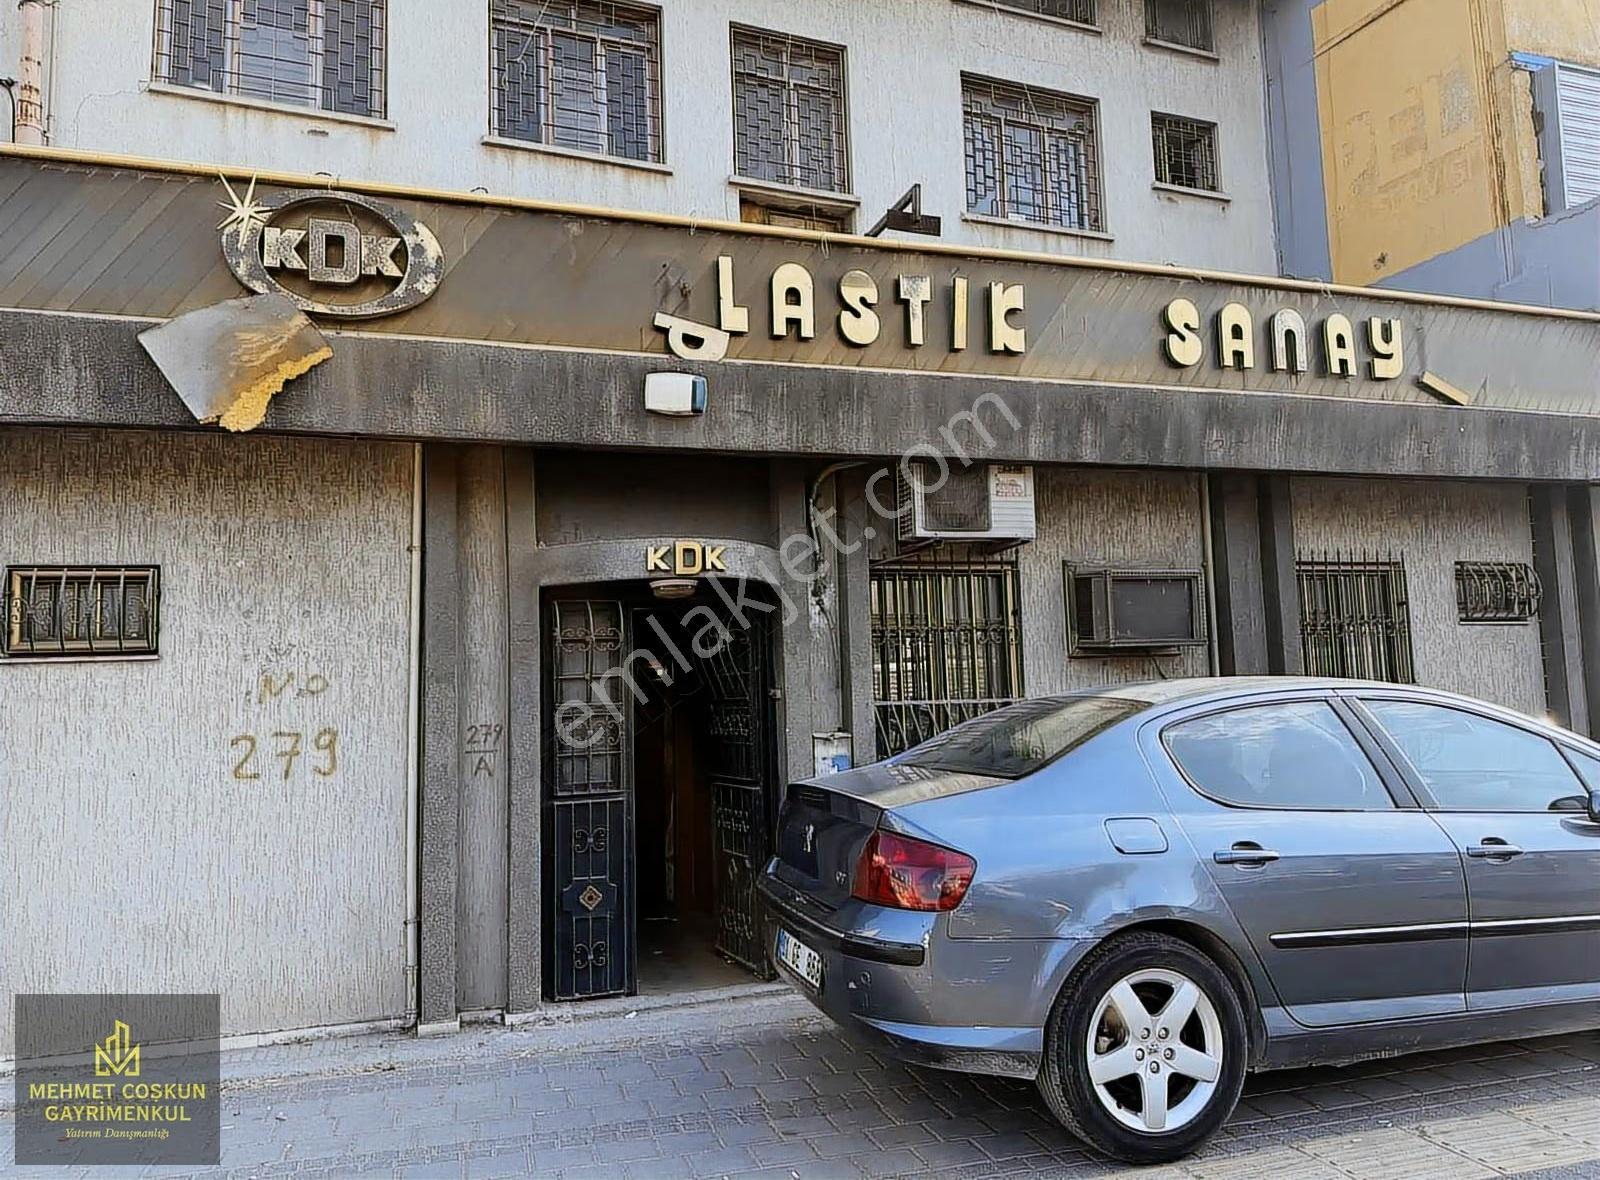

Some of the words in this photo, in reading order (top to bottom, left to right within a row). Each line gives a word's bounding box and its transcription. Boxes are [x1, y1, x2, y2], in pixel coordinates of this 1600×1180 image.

[263, 217, 404, 284] KDK
[646, 540, 728, 575] KDK
[466, 723, 502, 747] 279
[230, 727, 337, 780] 279
[474, 756, 494, 777] A
